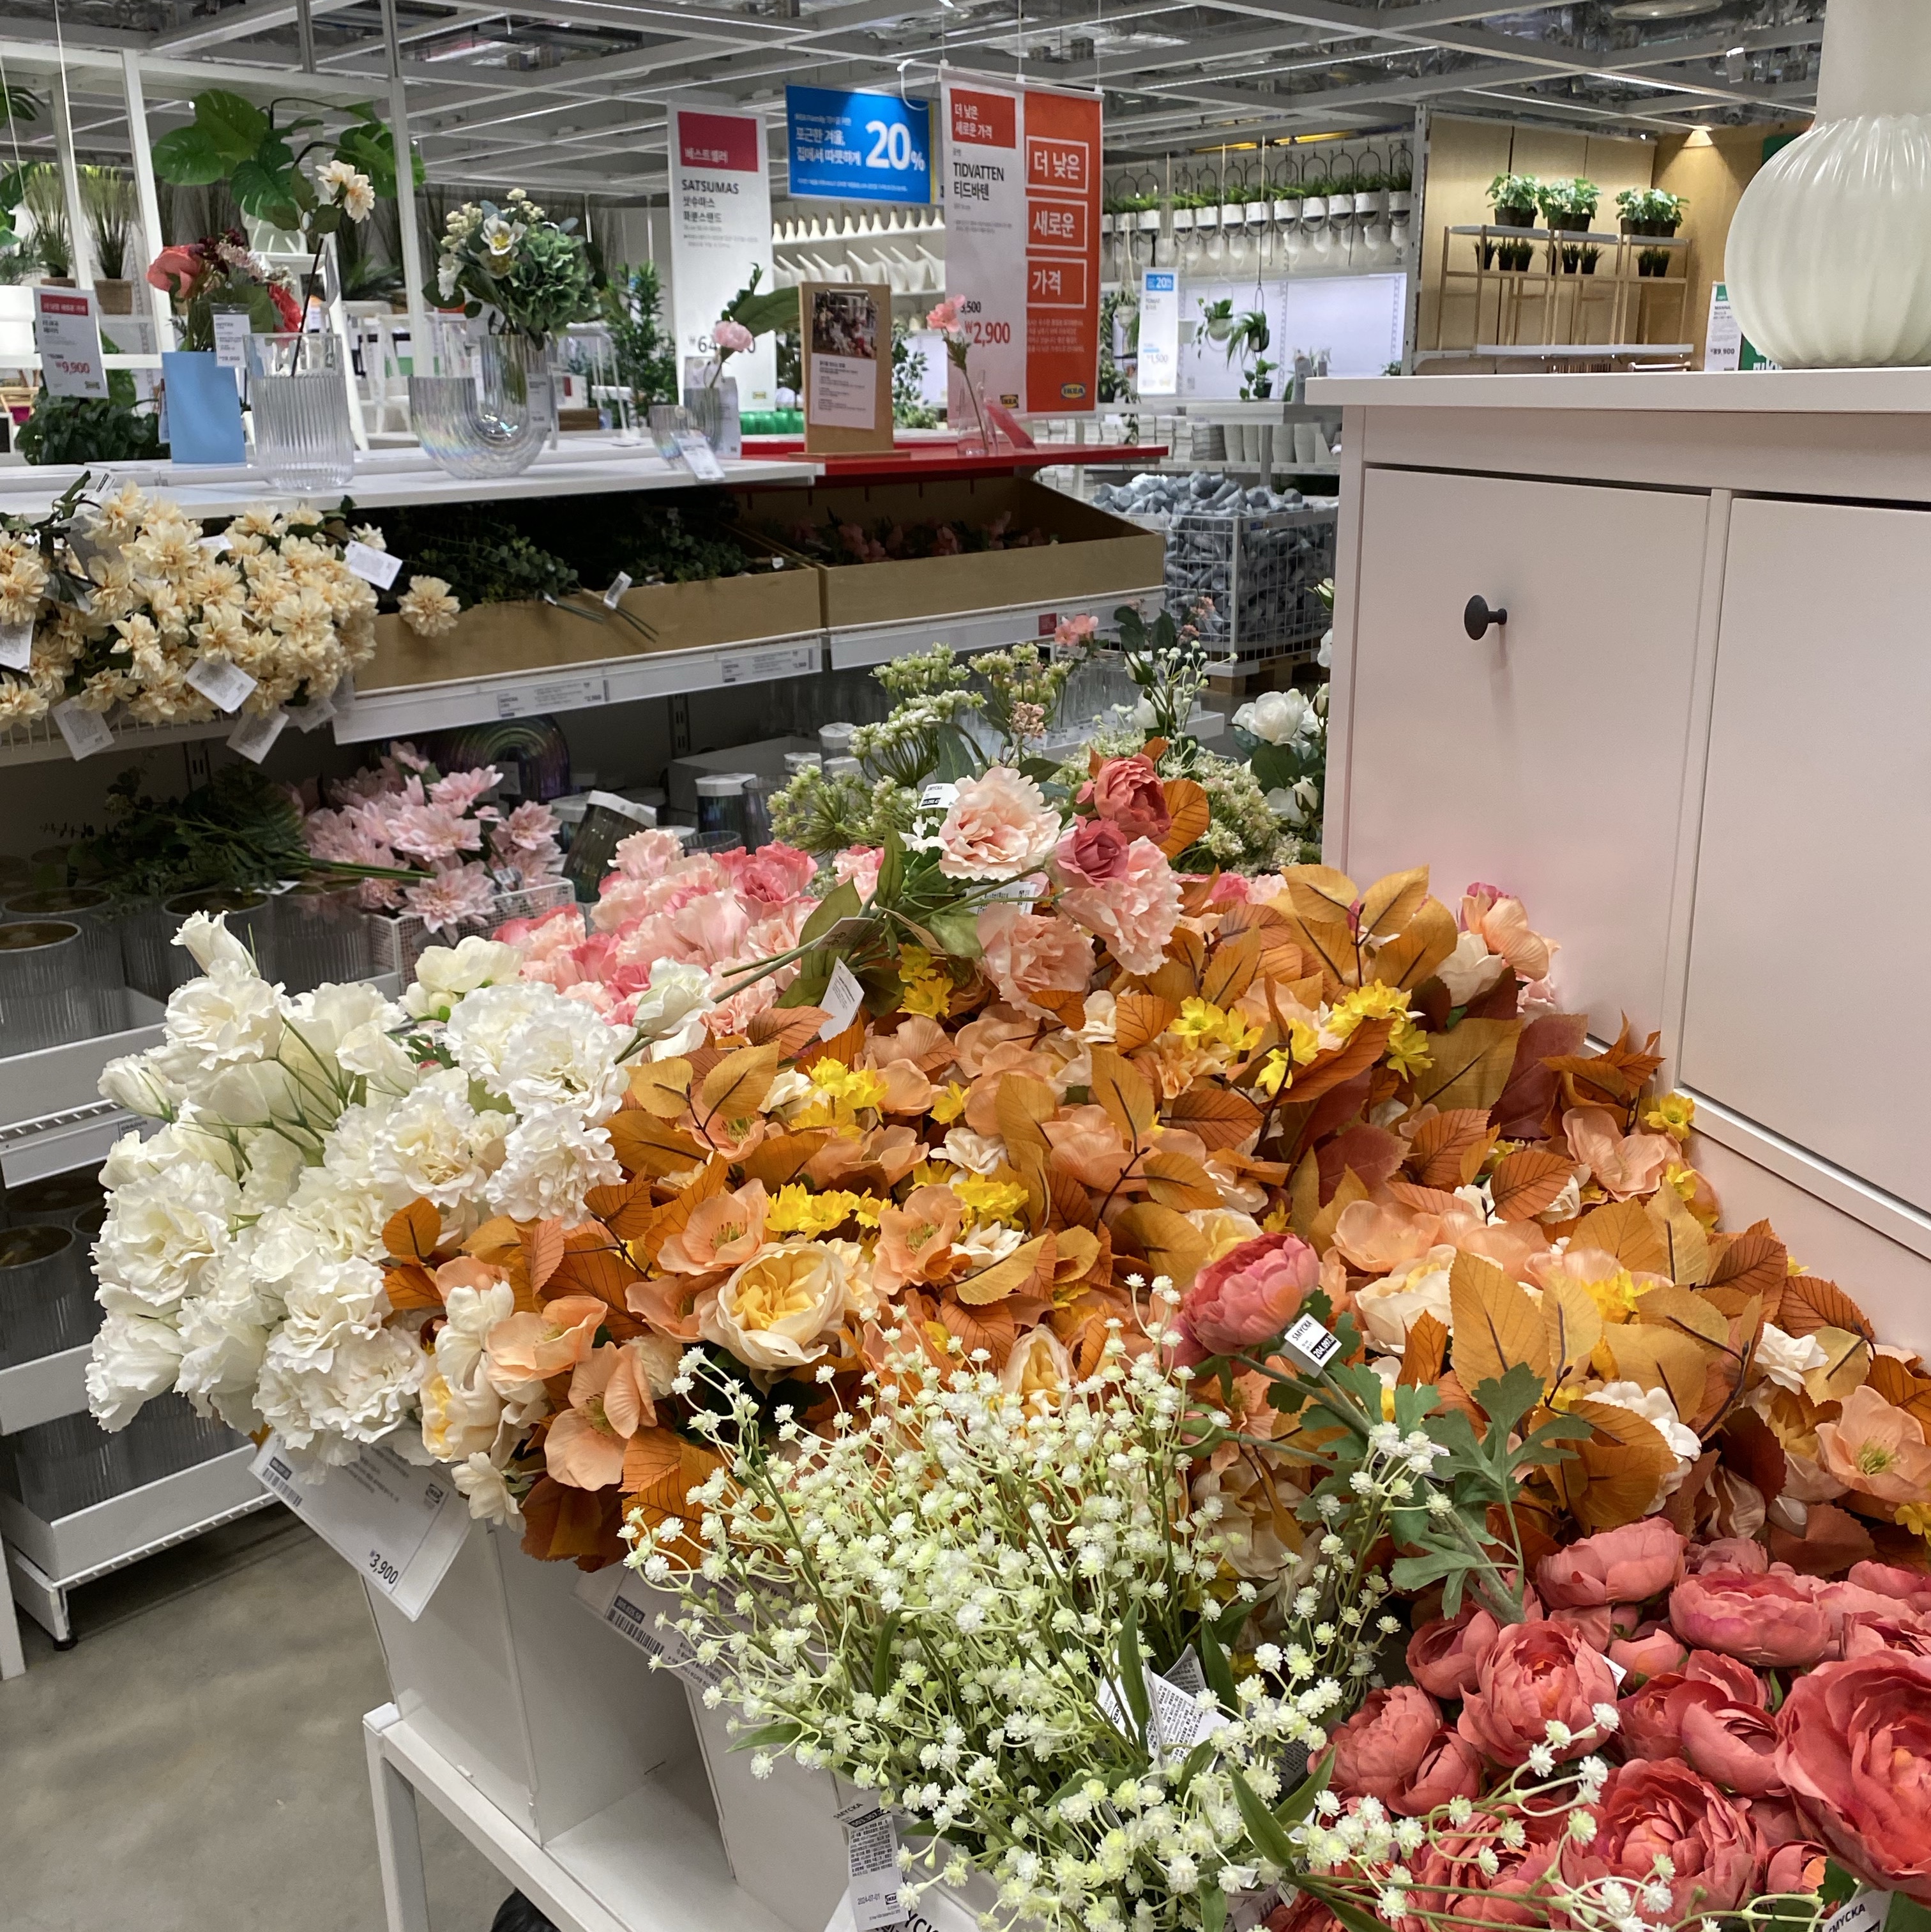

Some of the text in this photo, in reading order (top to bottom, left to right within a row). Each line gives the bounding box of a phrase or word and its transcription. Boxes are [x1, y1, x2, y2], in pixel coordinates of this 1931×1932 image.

[954, 102, 963, 118] 더
[865, 119, 926, 172] 20%
[953, 162, 1004, 181] TIDVATTEN
[1034, 150, 1080, 180] 더 낮은
[681, 179, 739, 194] SATSUMAS
[953, 180, 990, 201] 티드바텐
[1033, 210, 1075, 238] 새로운
[1032, 269, 1061, 295] 가격
[1292, 1320, 1313, 1341] SMYCKA
[833, 1803, 864, 1819] SMYCKA
[857, 1893, 881, 1906] 2024-07-01
